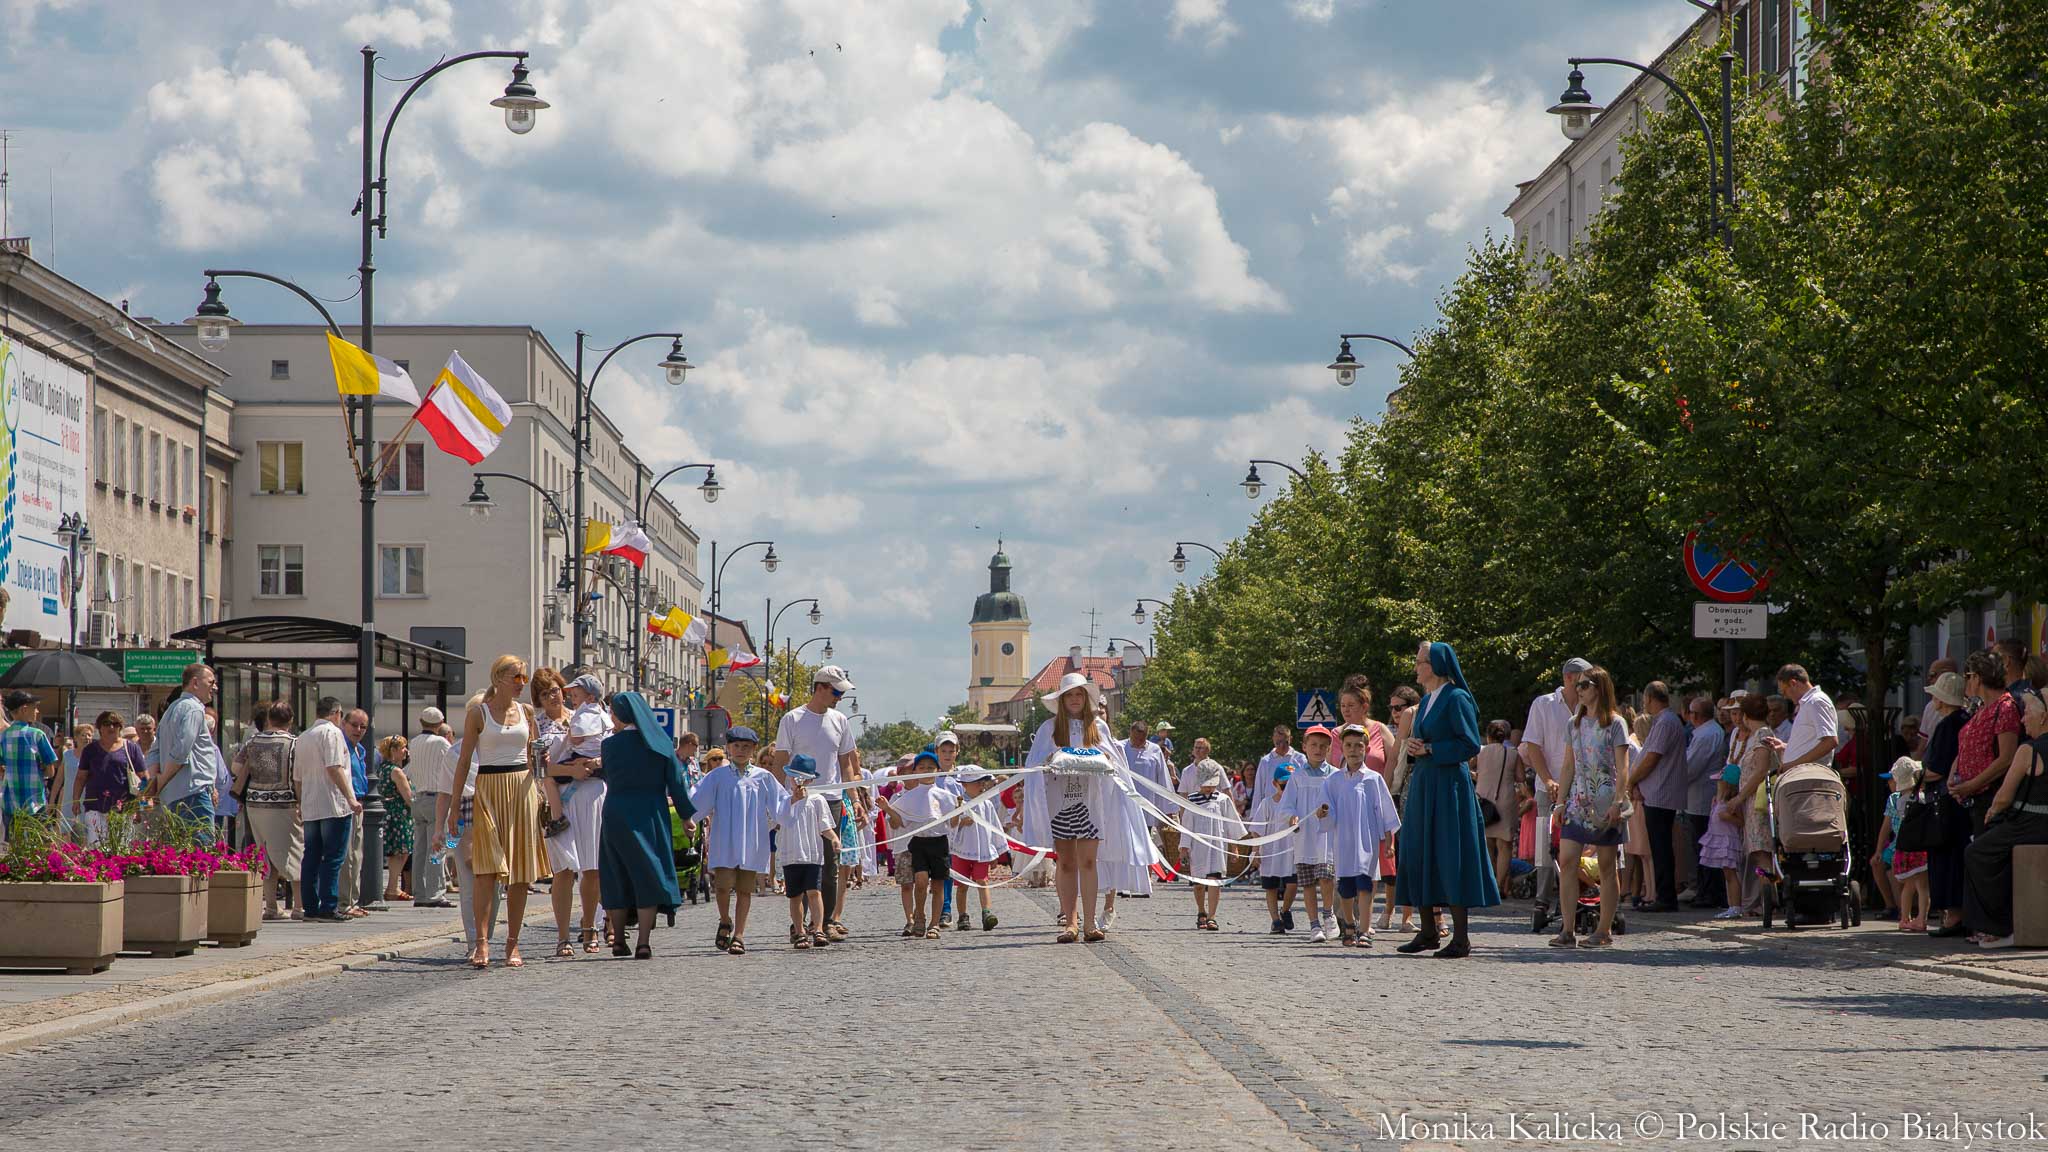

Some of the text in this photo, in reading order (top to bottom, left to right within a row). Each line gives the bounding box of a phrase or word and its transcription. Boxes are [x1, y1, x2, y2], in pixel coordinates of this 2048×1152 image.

[22, 371, 44, 408] Festiwal
[1708, 606, 1753, 615] Obowiązuje
[1723, 617, 1745, 625] godz.
